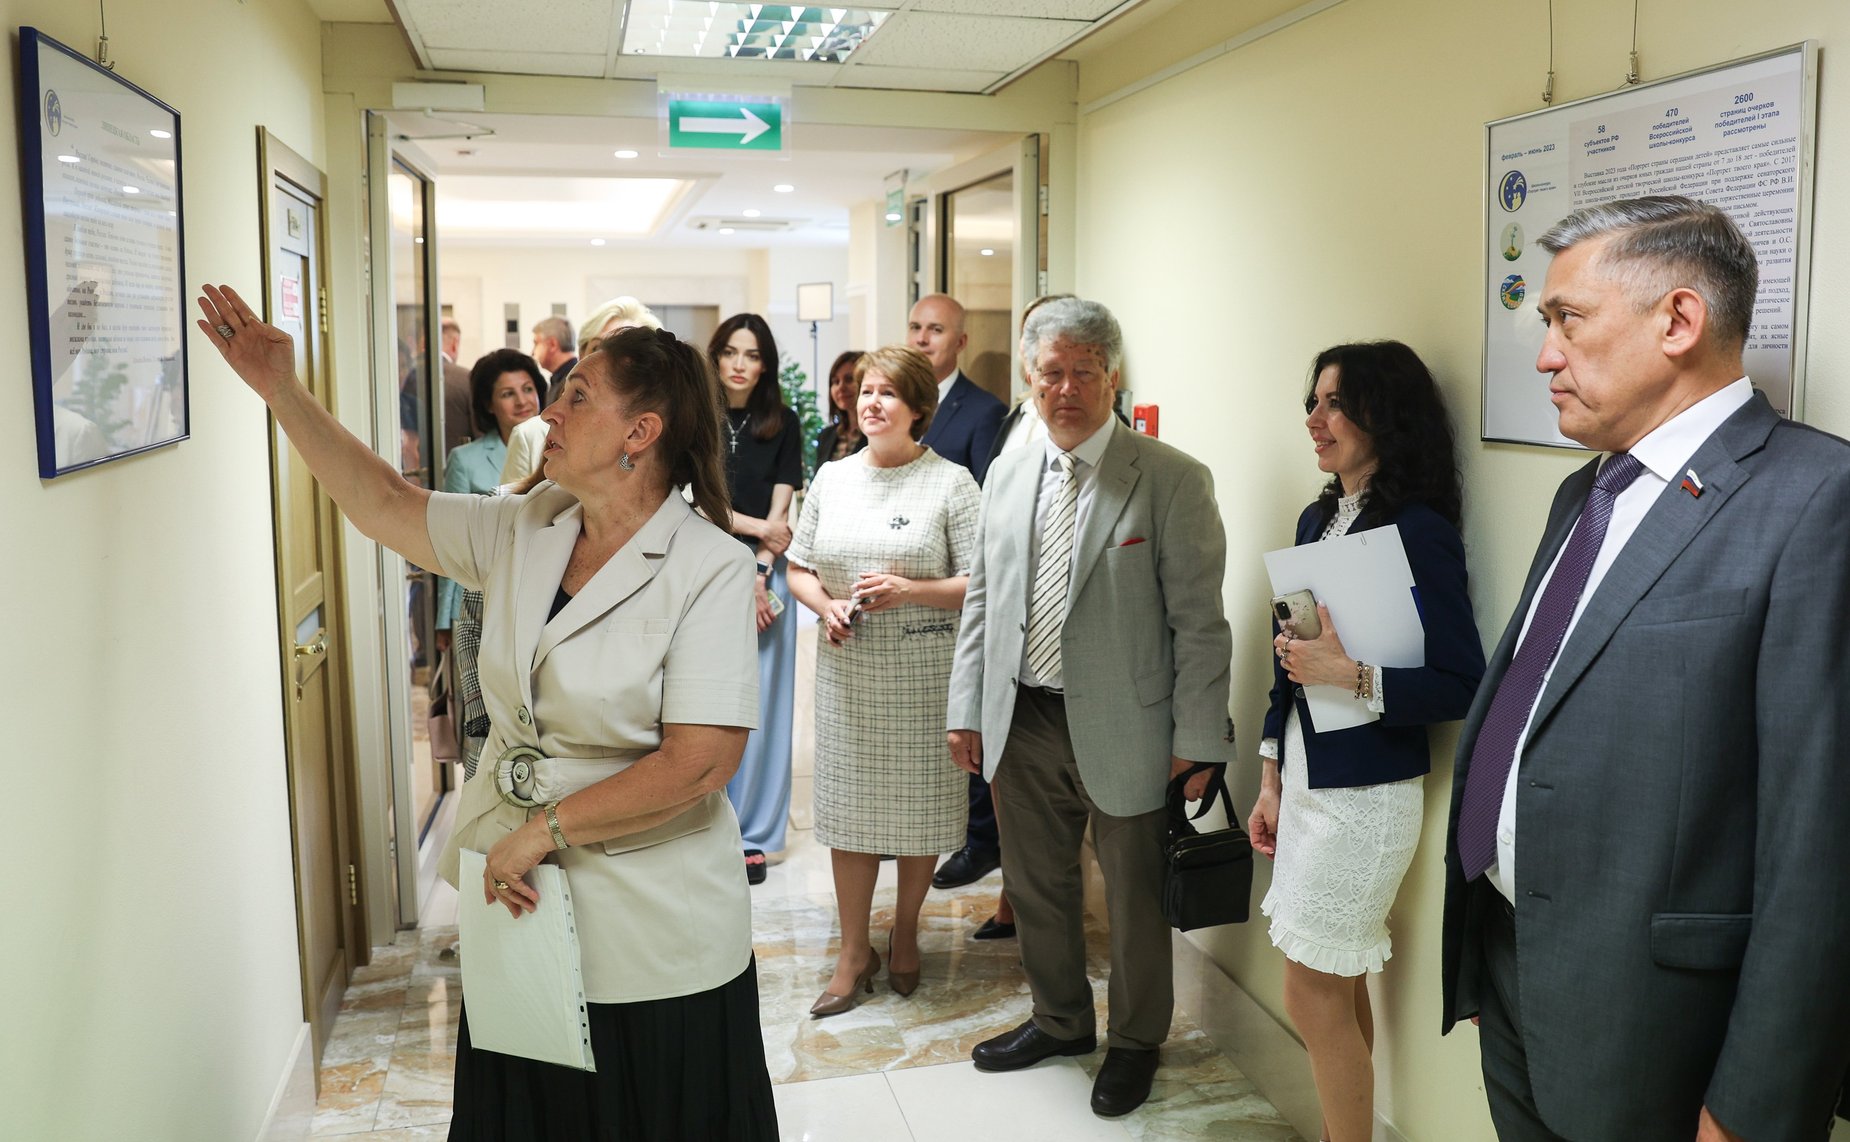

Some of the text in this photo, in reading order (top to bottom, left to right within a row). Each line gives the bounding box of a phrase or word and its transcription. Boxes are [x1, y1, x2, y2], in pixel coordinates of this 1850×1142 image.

[1734, 92, 1754, 105] 2600
[1665, 108, 1679, 118] 470
[1720, 101, 1775, 118] страниц очерков
[1652, 117, 1690, 131] победителей
[1714, 114, 1756, 129] победителей
[1761, 110, 1780, 120] этапа
[1597, 125, 1606, 134] 58
[1649, 126, 1693, 140] Всероссийской
[1722, 123, 1767, 138] рассмотрены
[1584, 137, 1610, 148] субъектов
[1648, 135, 1696, 149] школы-конкурса
[1501, 151, 1524, 161] февраль
[1528, 147, 1542, 156] июнь
[1543, 144, 1556, 152] 2023
[1584, 170, 1604, 179] Выставка
[1628, 162, 1650, 171] «Портрет
[1651, 160, 1668, 168] страны
[1670, 155, 1694, 164] сердцами
[1695, 151, 1712, 160] детей»
[1714, 145, 1750, 157] представляет
[1752, 141, 1769, 150] самые
[1770, 136, 1796, 146] сильные
[1587, 145, 1616, 157] участников
[1620, 174, 1638, 182] очерков
[1654, 168, 1674, 176] граждан
[1676, 164, 1692, 172] нашей
[1693, 161, 1712, 170] страны
[1758, 146, 1796, 158] победителей
[1663, 172, 1704, 183] школы-конкурса
[1706, 168, 1732, 176] «Портрет
[1781, 156, 1796, 164] 2017
[1649, 184, 1676, 194] Российской
[1680, 180, 1708, 189] Федерации
[1724, 174, 1754, 182] поддержке
[1757, 166, 1796, 178] сенаторского
[1706, 187, 1724, 195] Совета
[1726, 183, 1756, 192] Федерации
[1770, 178, 1780, 186] РФ
[1720, 192, 1760, 202] торжественные
[1762, 187, 1794, 197] церемонии
[1754, 207, 1794, 218] действующих
[1748, 218, 1792, 228] Святославовны
[1754, 228, 1792, 237] деятельности
[1766, 258, 1792, 266] развития
